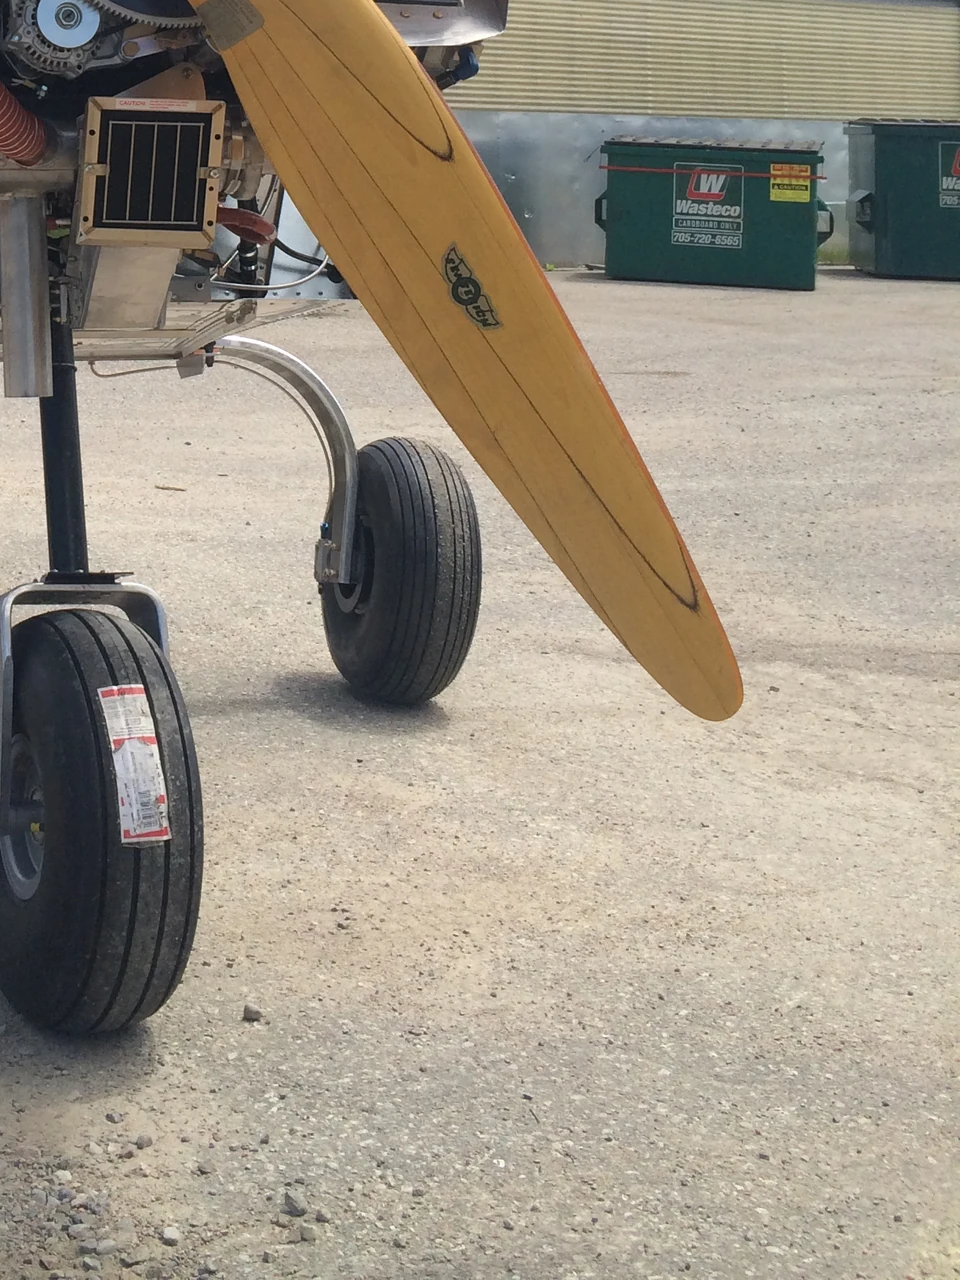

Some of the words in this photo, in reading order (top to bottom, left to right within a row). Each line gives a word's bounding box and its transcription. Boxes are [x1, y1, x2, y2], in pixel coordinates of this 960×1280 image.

[675, 199, 741, 217] Wasteco
[678, 220, 718, 228] CARDBOARD
[673, 233, 740, 246] 705-720-6565
